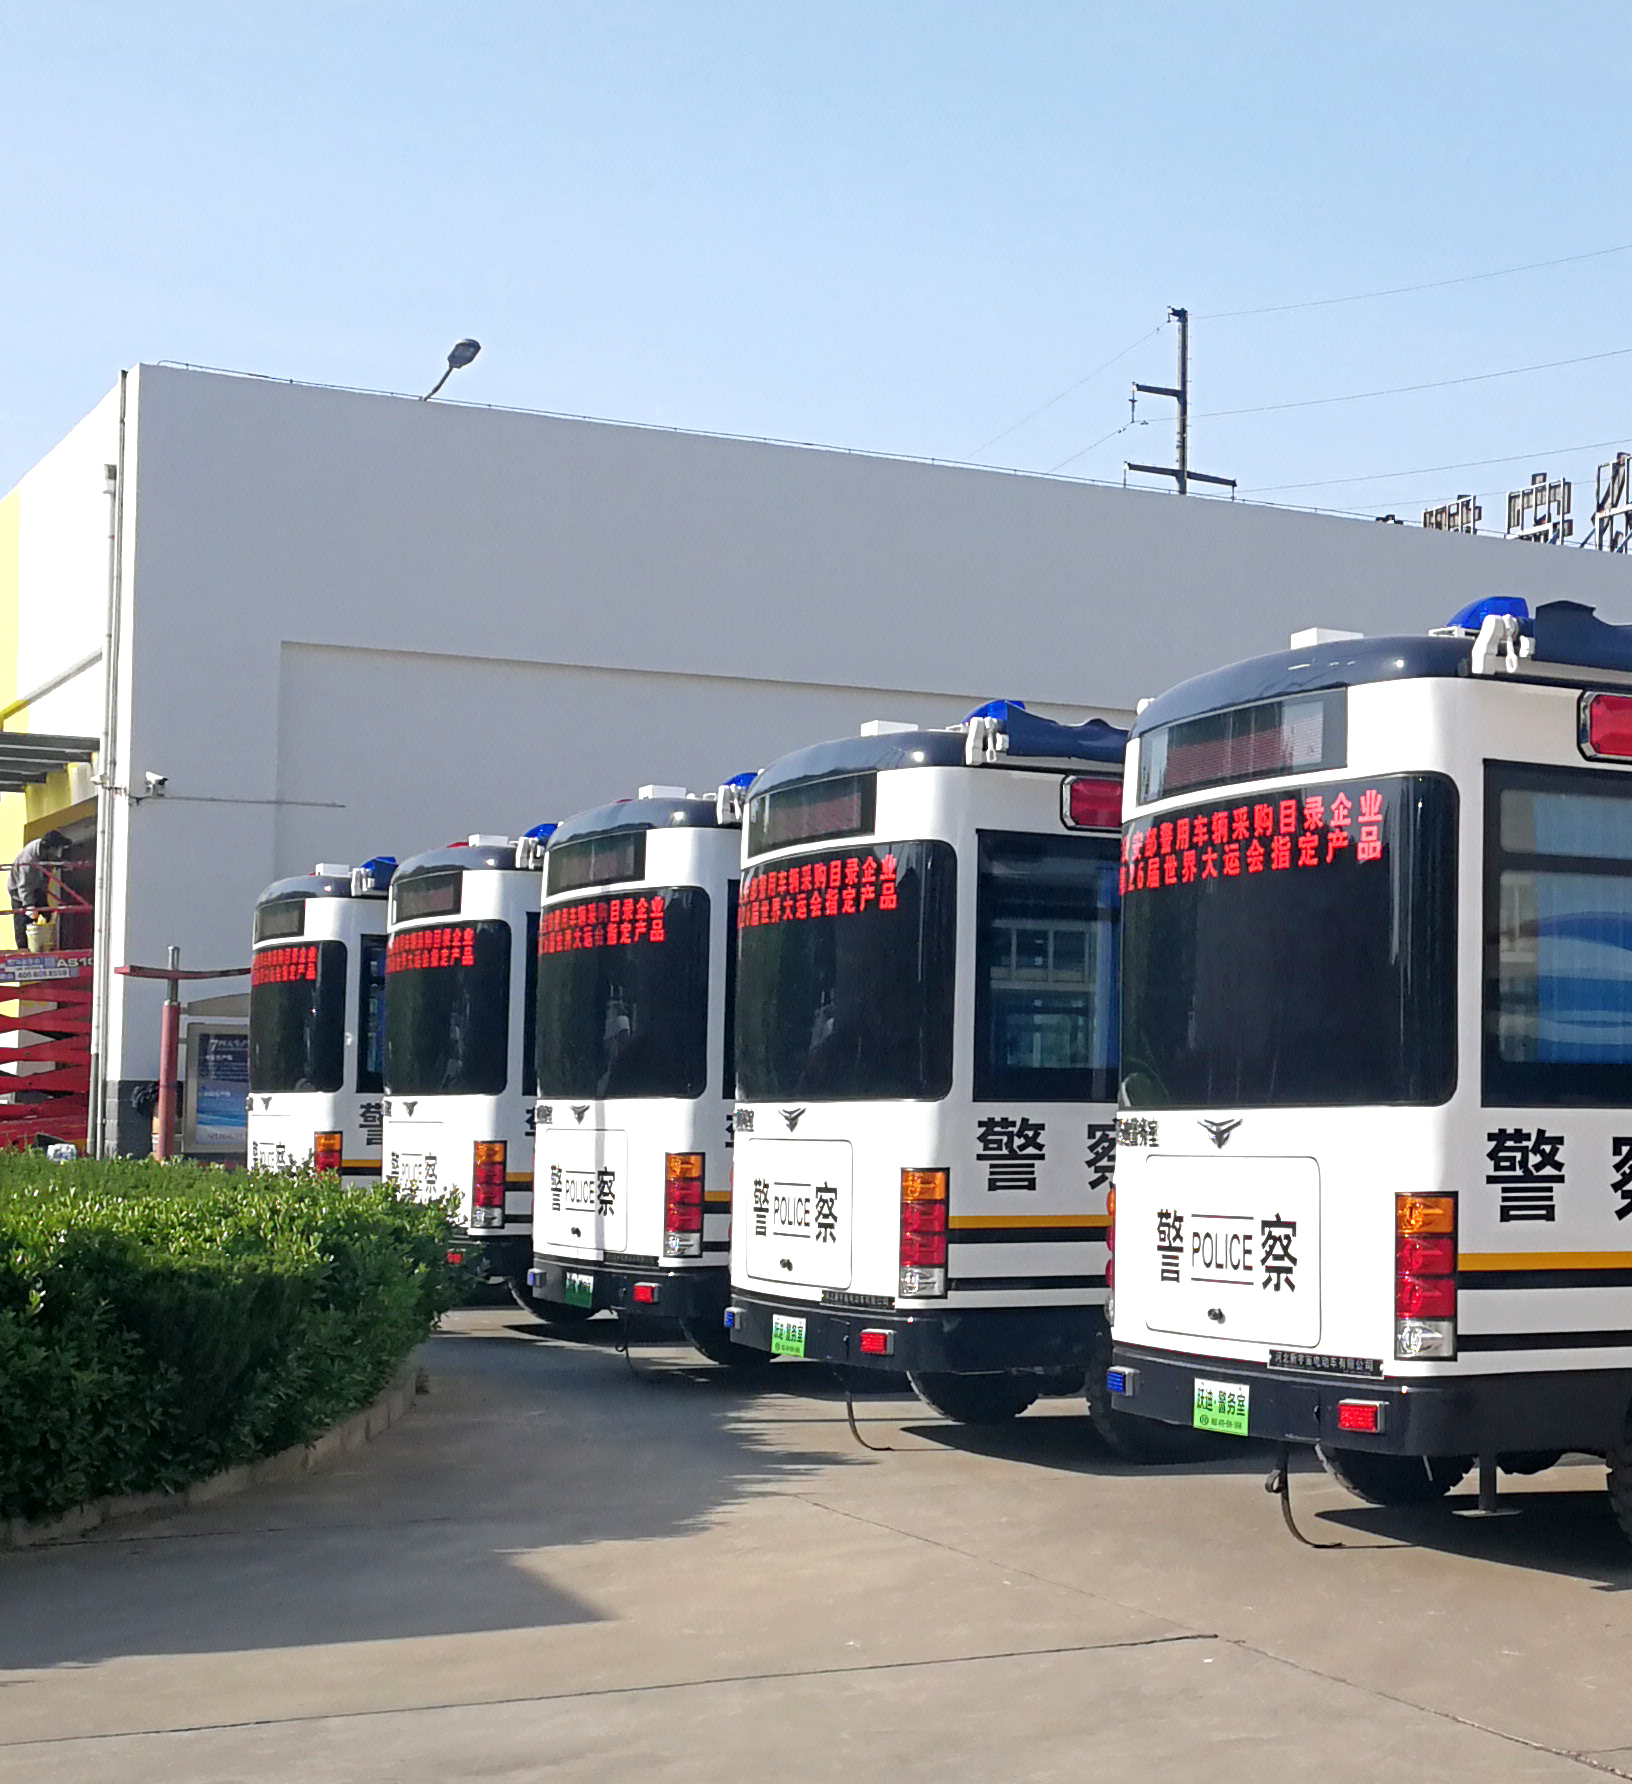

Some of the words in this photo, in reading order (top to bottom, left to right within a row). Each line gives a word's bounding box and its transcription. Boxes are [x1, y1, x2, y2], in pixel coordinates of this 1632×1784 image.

[551, 1164, 562, 1212] 警
[565, 1179, 595, 1204] POLICE
[597, 1166, 616, 1217] 察
[753, 1178, 770, 1237] 警
[773, 1196, 811, 1228] POLICE
[814, 1181, 838, 1244] 察
[1157, 1208, 1184, 1283] 警
[1192, 1231, 1253, 1272] POLICE
[1260, 1212, 1298, 1293] 察
